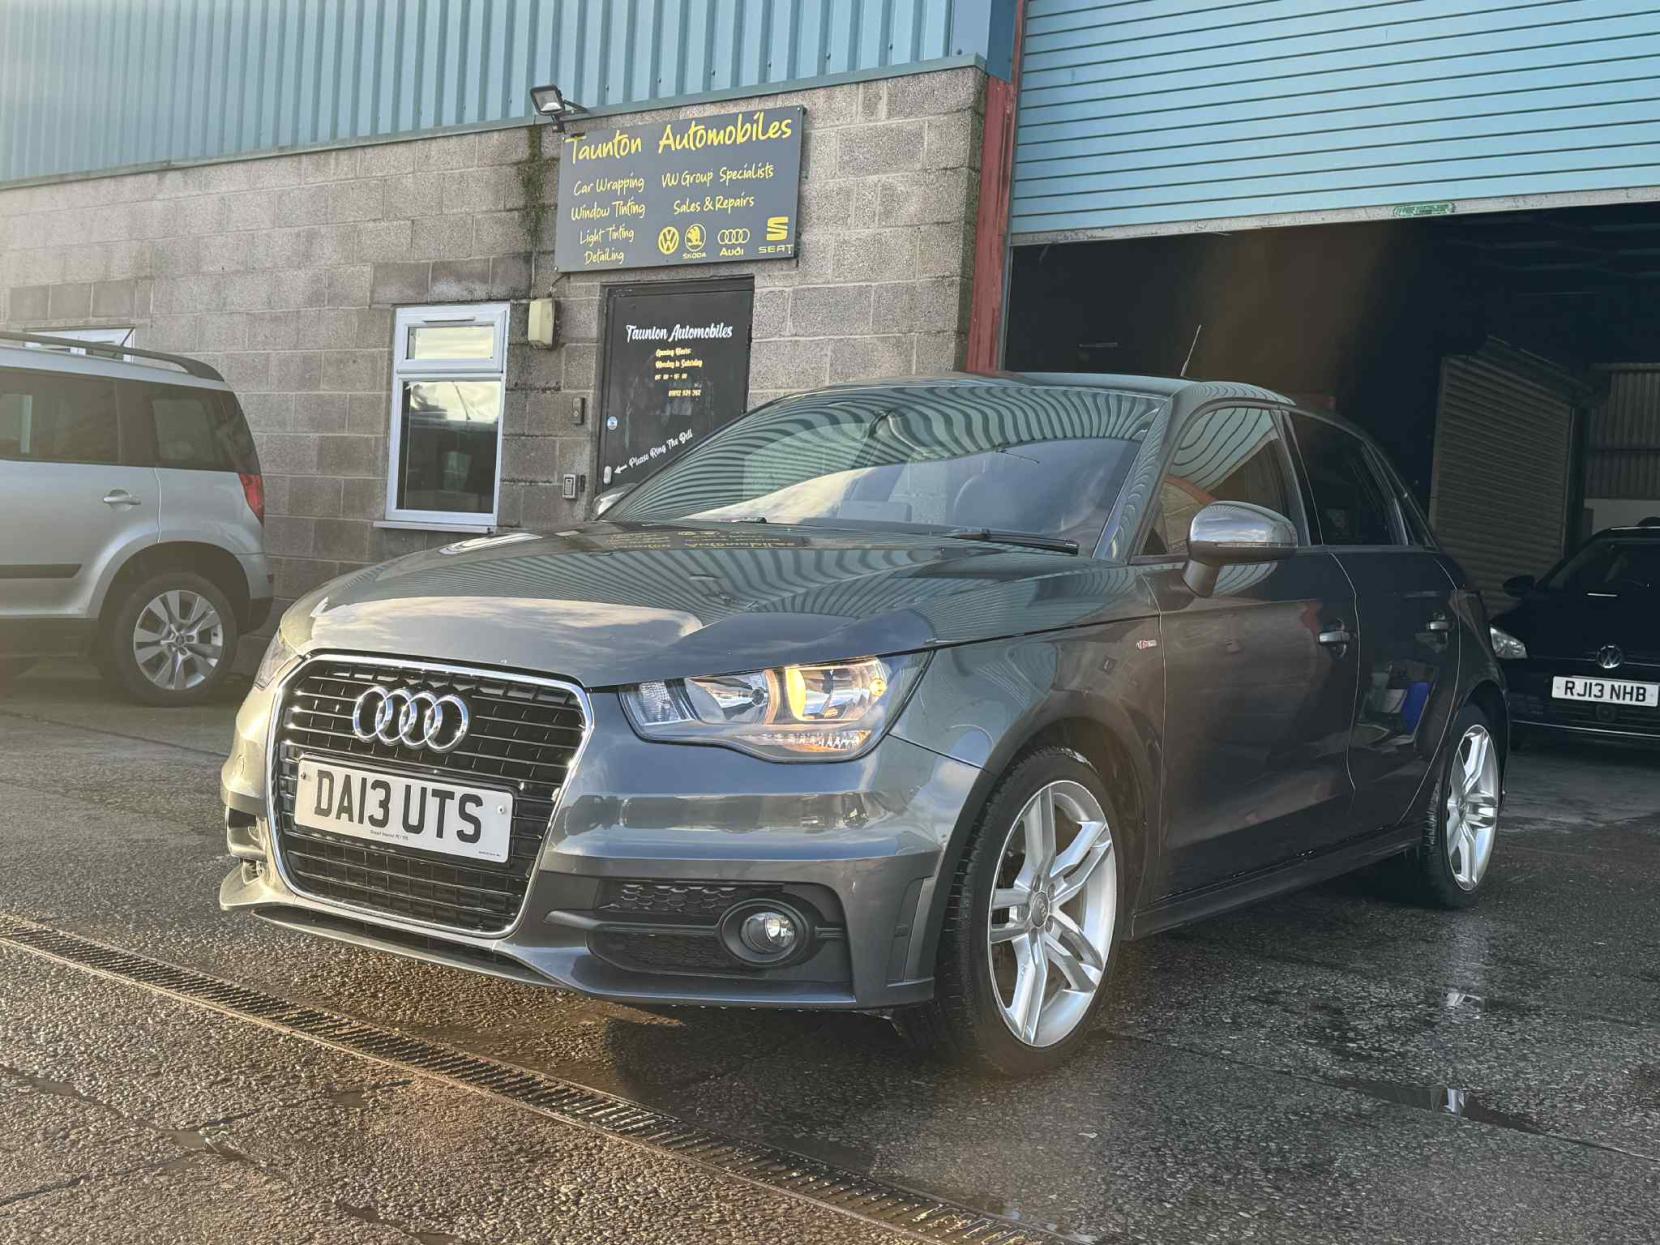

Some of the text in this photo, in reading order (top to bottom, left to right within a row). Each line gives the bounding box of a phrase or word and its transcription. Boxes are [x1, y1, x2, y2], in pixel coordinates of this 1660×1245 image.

[564, 111, 792, 165] Taunton Automobiles
[573, 172, 645, 196] Car Wrapping
[661, 162, 775, 188] VW Group Specialists
[571, 196, 646, 221] Window Tinting
[673, 191, 755, 215] Sales & Repairs
[580, 223, 635, 247] Light Tinting
[584, 248, 625, 266] Detailing
[719, 246, 744, 257] Audi
[758, 244, 794, 254] SEAT
[625, 322, 733, 343] Taunton Automobiles
[628, 454, 650, 468] Please
[649, 445, 667, 459] Ring
[666, 438, 679, 450] The
[1564, 680, 1647, 703] RJ13 NHB
[314, 769, 484, 844] DA13 UTS
